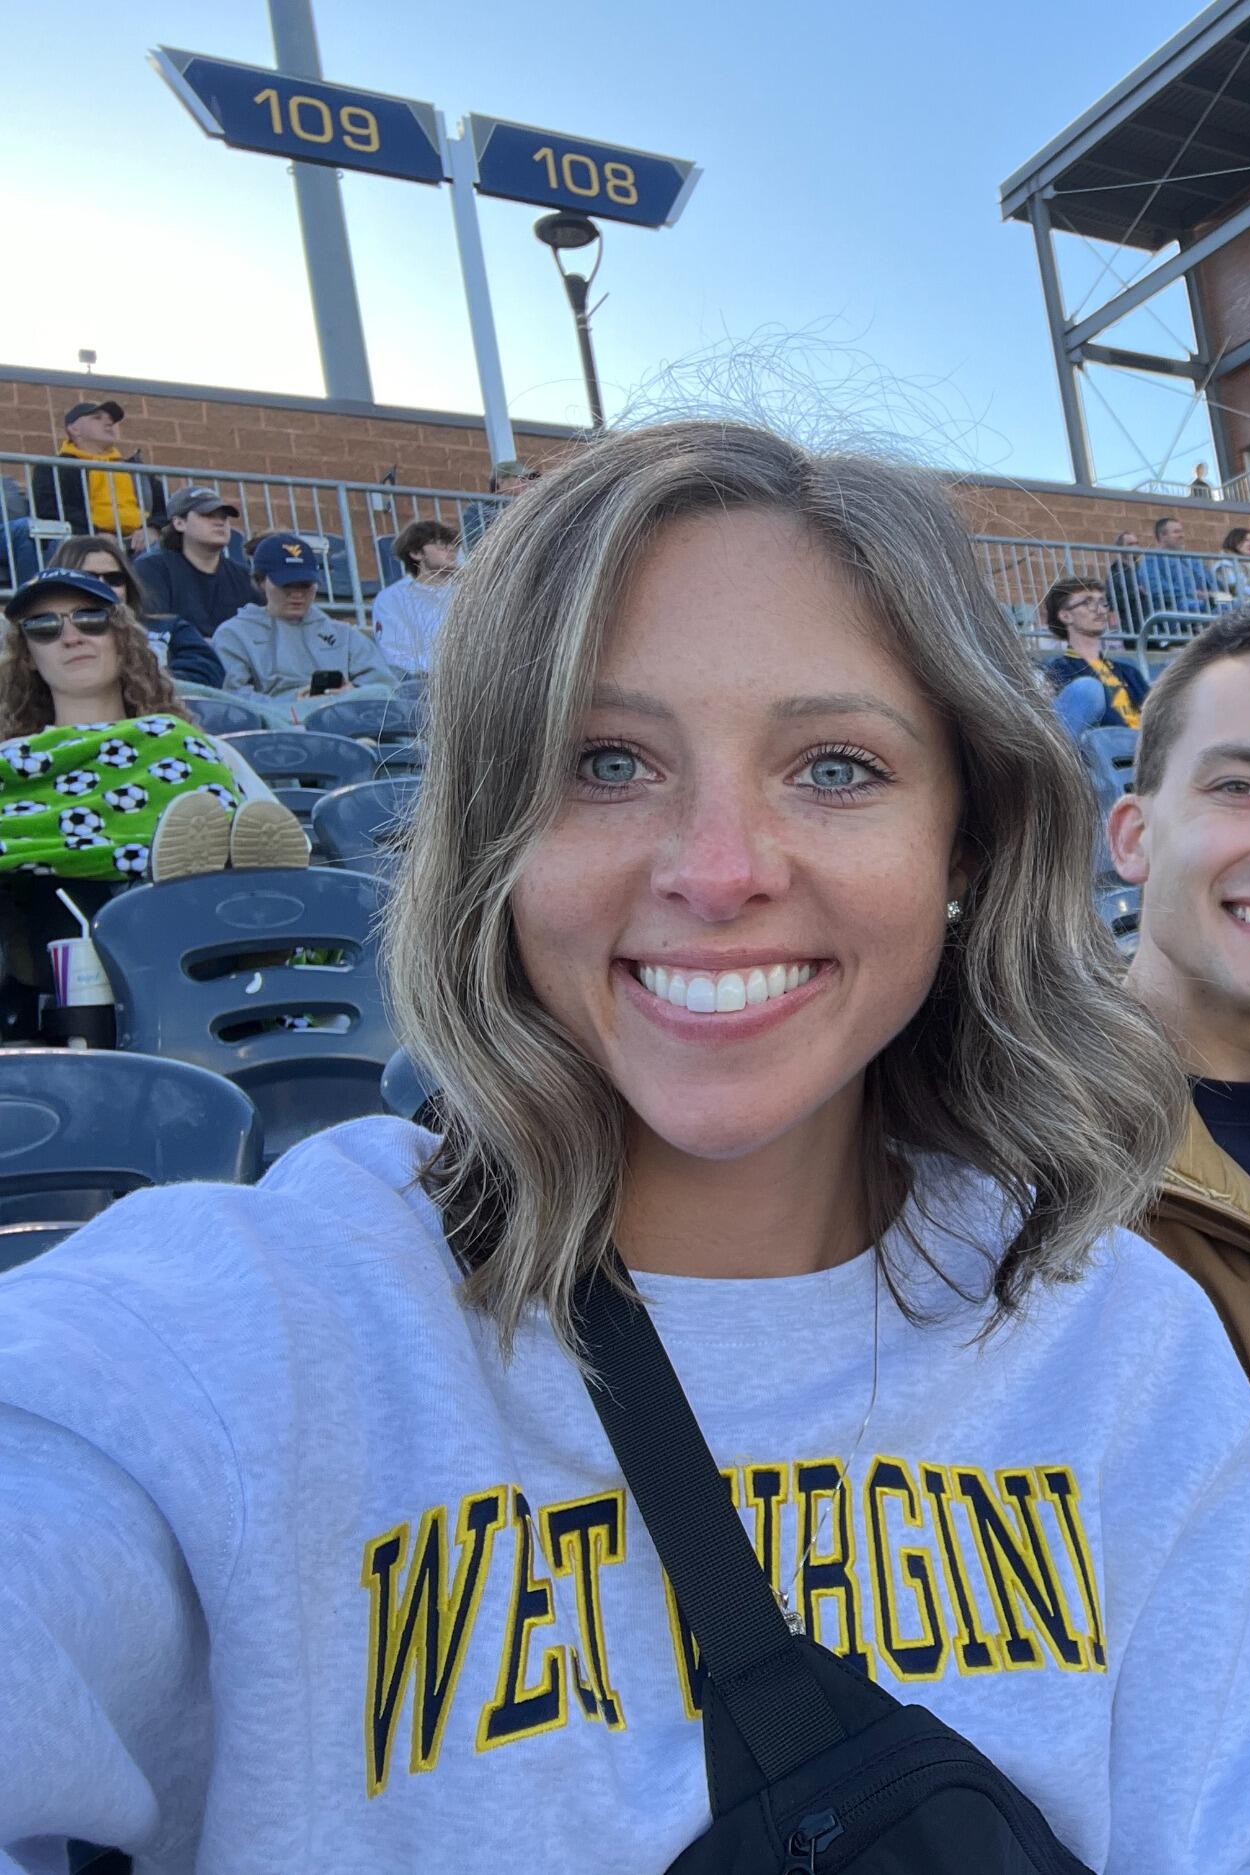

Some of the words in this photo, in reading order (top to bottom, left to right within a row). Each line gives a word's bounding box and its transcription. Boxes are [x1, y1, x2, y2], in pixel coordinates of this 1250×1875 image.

[253, 88, 380, 153] 109
[532, 147, 638, 205] 108
[361, 1484, 626, 1800] WET
